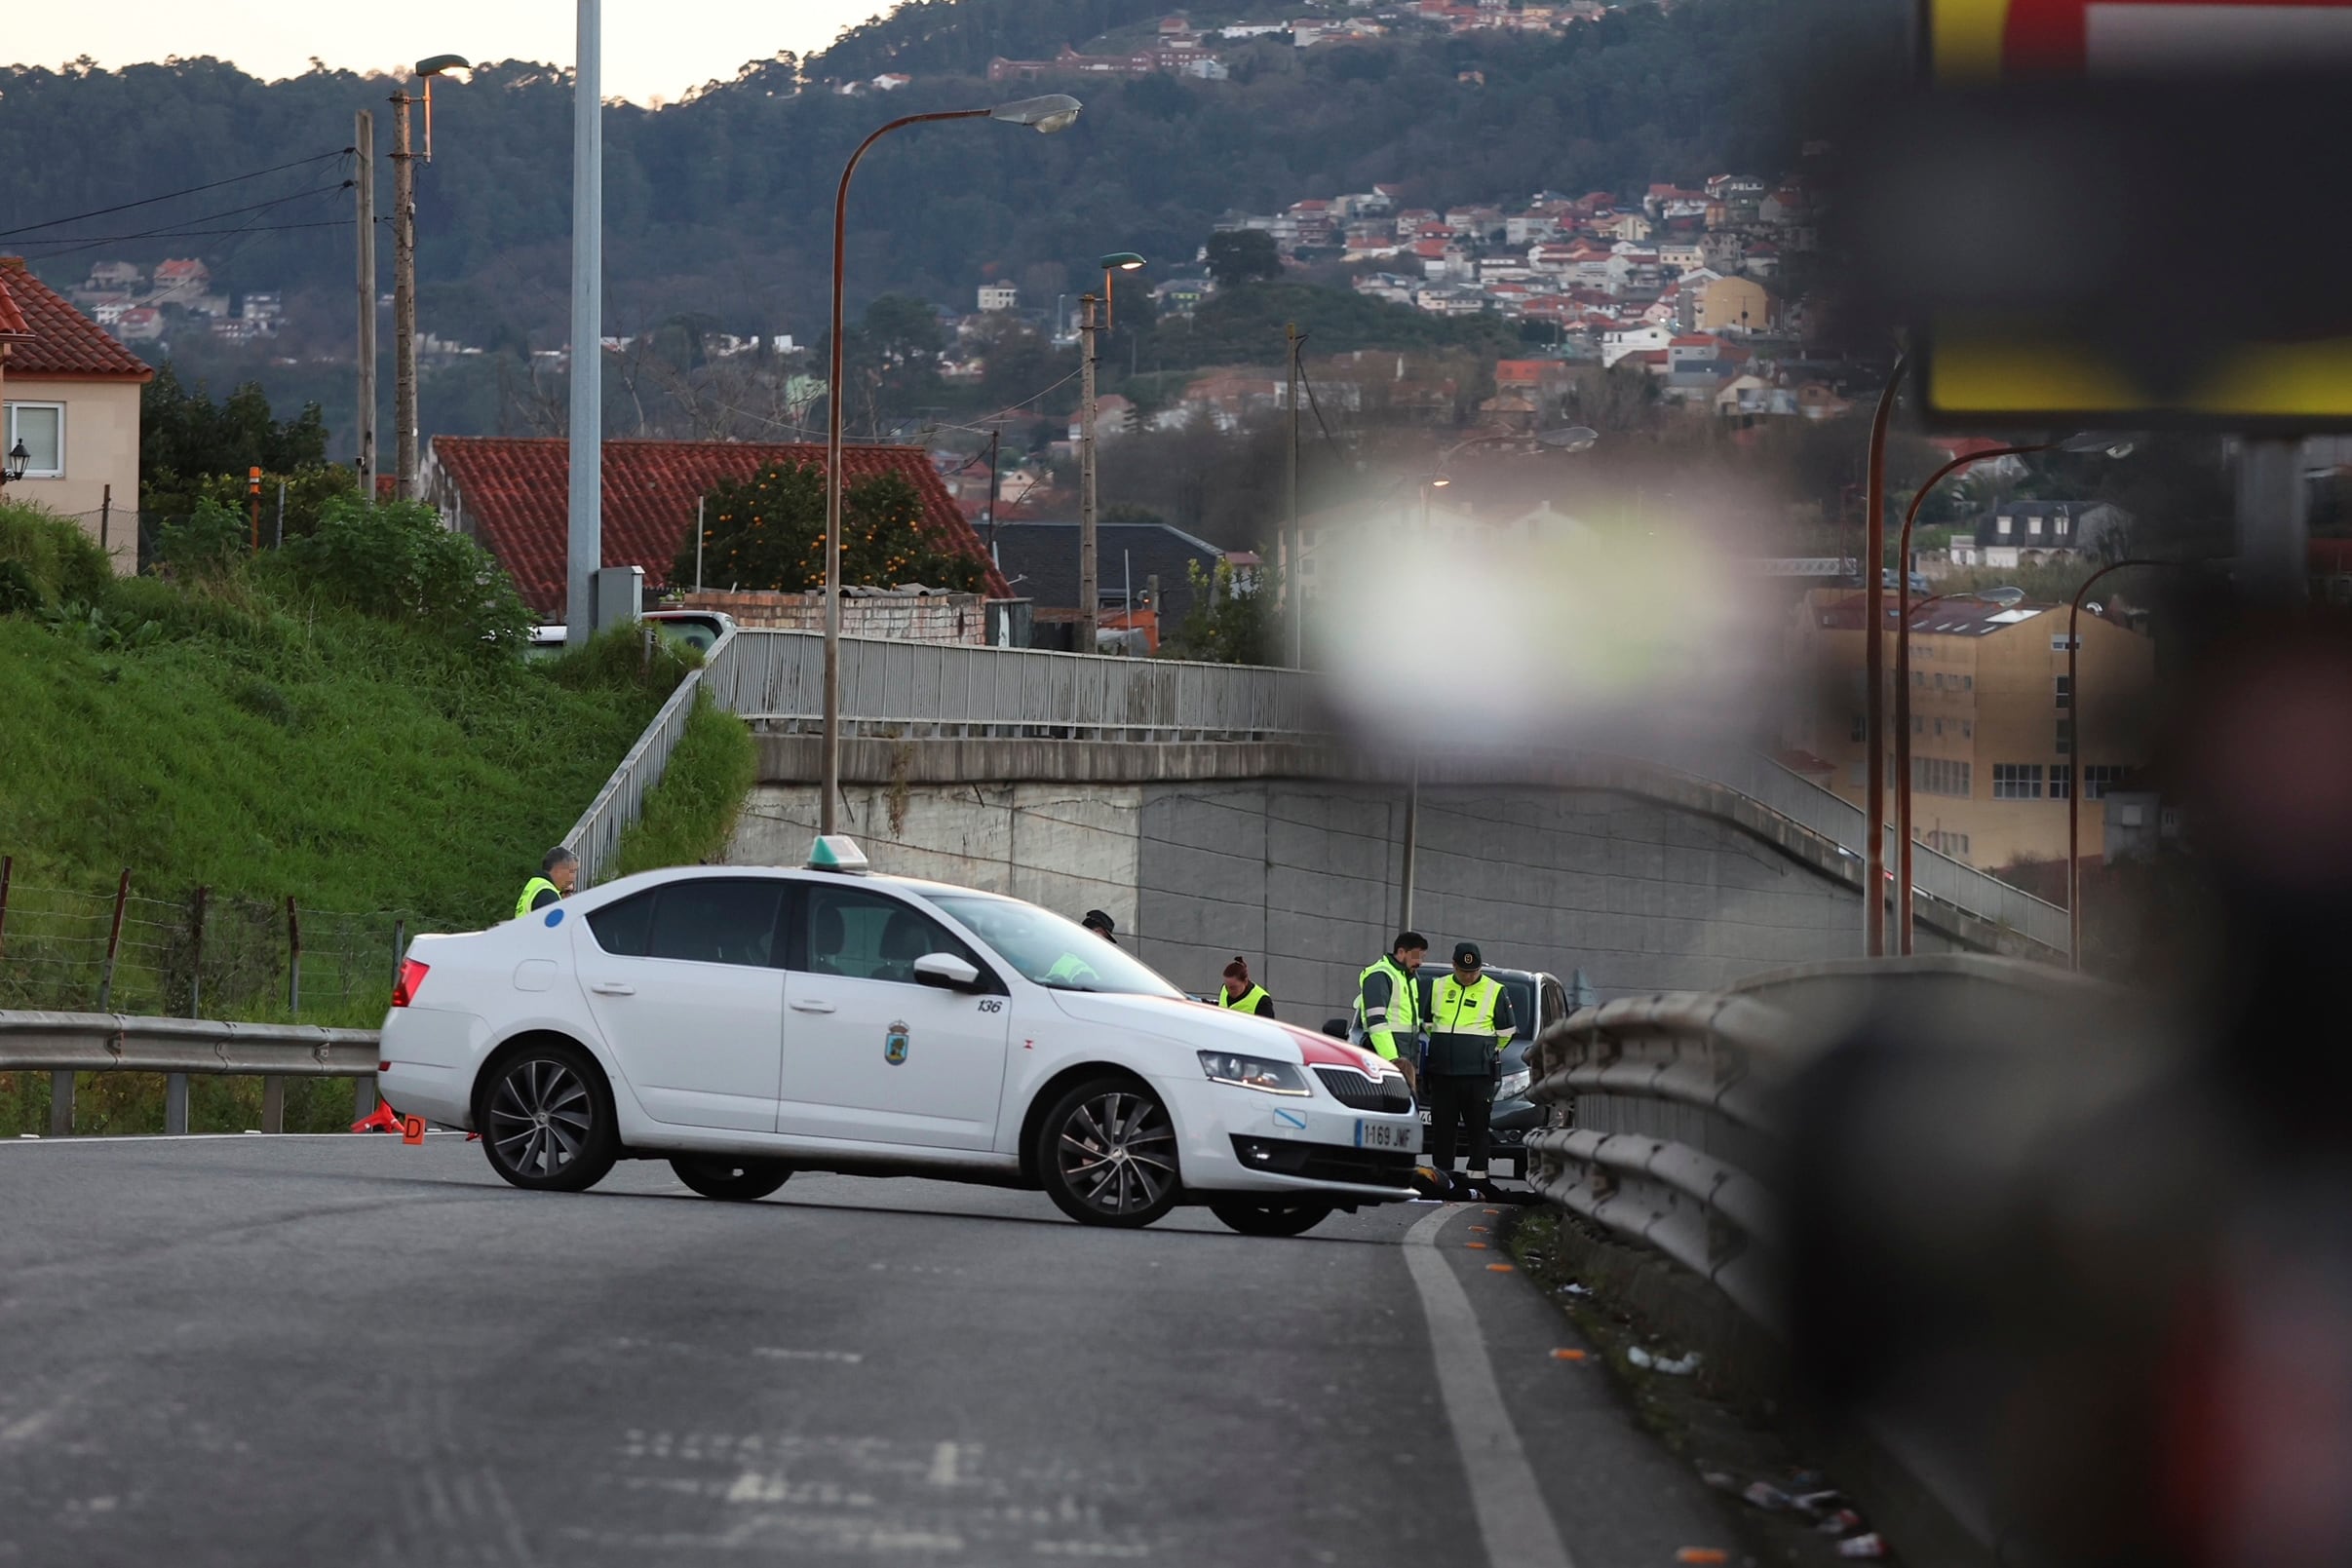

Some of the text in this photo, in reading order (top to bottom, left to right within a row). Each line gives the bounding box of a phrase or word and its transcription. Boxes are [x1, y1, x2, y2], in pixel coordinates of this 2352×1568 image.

[978, 999, 1003, 1013] 136
[405, 1118, 421, 1138] D
[1365, 1124, 1391, 1146] 1169
